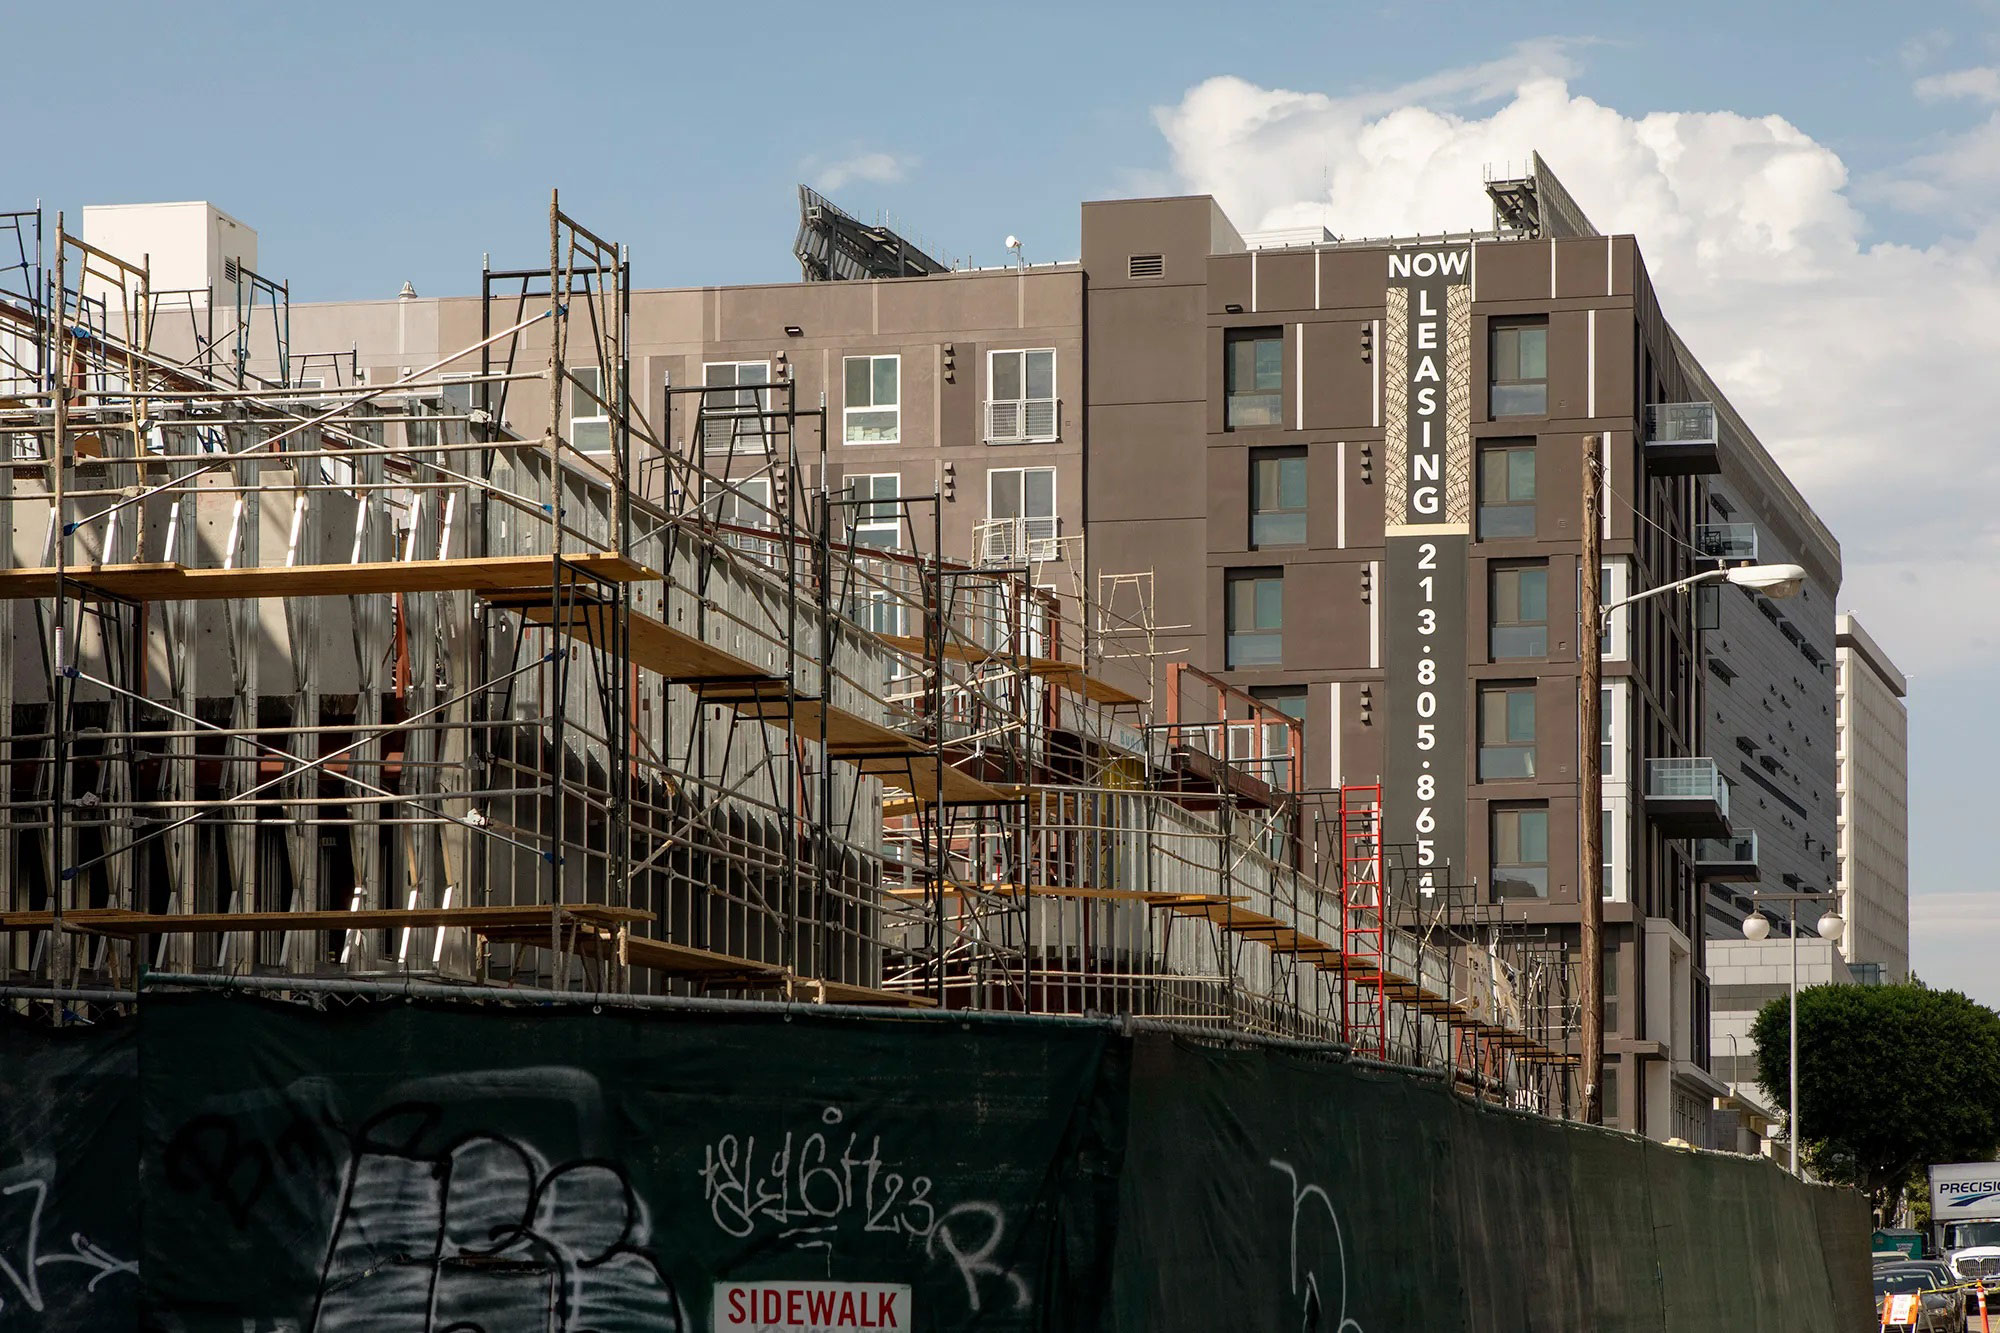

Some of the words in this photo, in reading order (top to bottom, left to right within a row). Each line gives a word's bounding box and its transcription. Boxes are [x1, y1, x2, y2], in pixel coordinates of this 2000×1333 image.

[1388, 250, 1469, 278] NOW
[1413, 290, 1440, 514] LEASING
[728, 1288, 898, 1328] SIDEWALK
